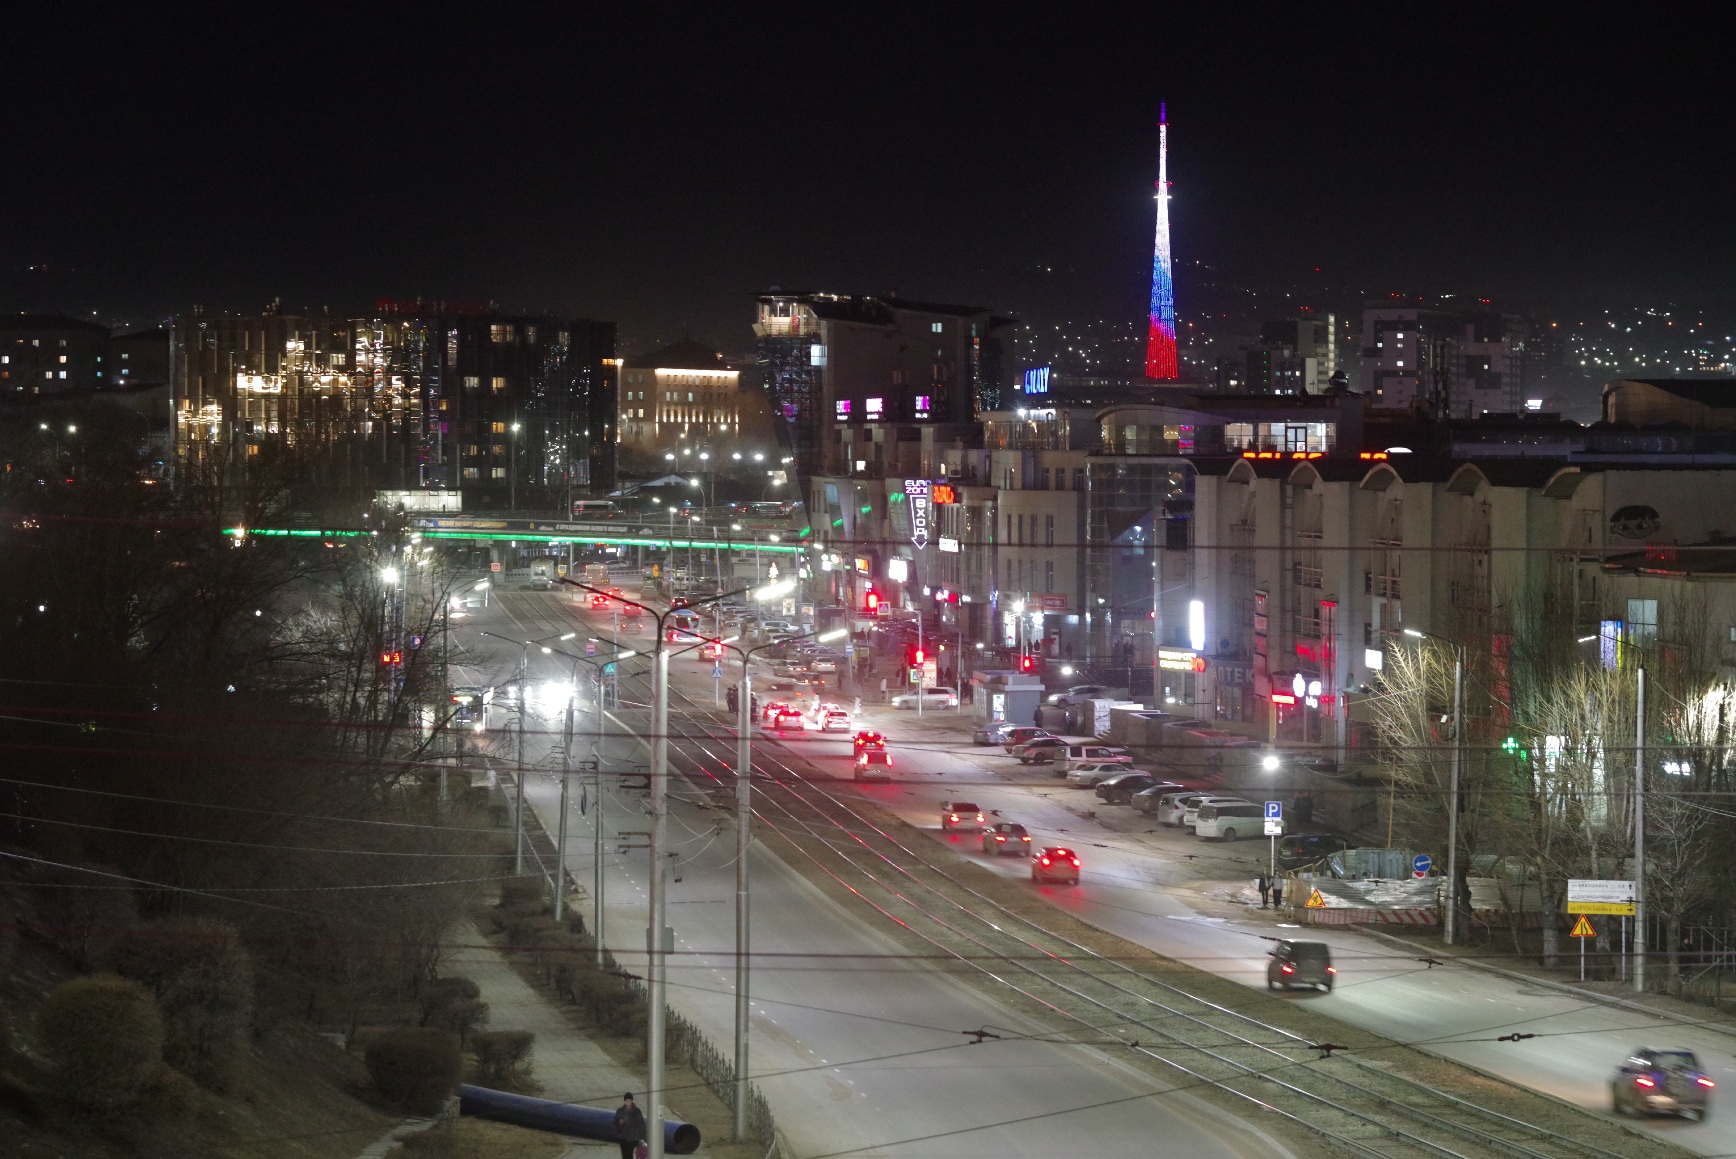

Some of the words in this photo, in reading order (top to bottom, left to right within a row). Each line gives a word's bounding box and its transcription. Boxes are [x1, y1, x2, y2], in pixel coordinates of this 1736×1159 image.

[915, 498, 928, 536] ВХОД
[1213, 665, 1255, 683] АПТЕК
[1268, 803, 1279, 817] P
